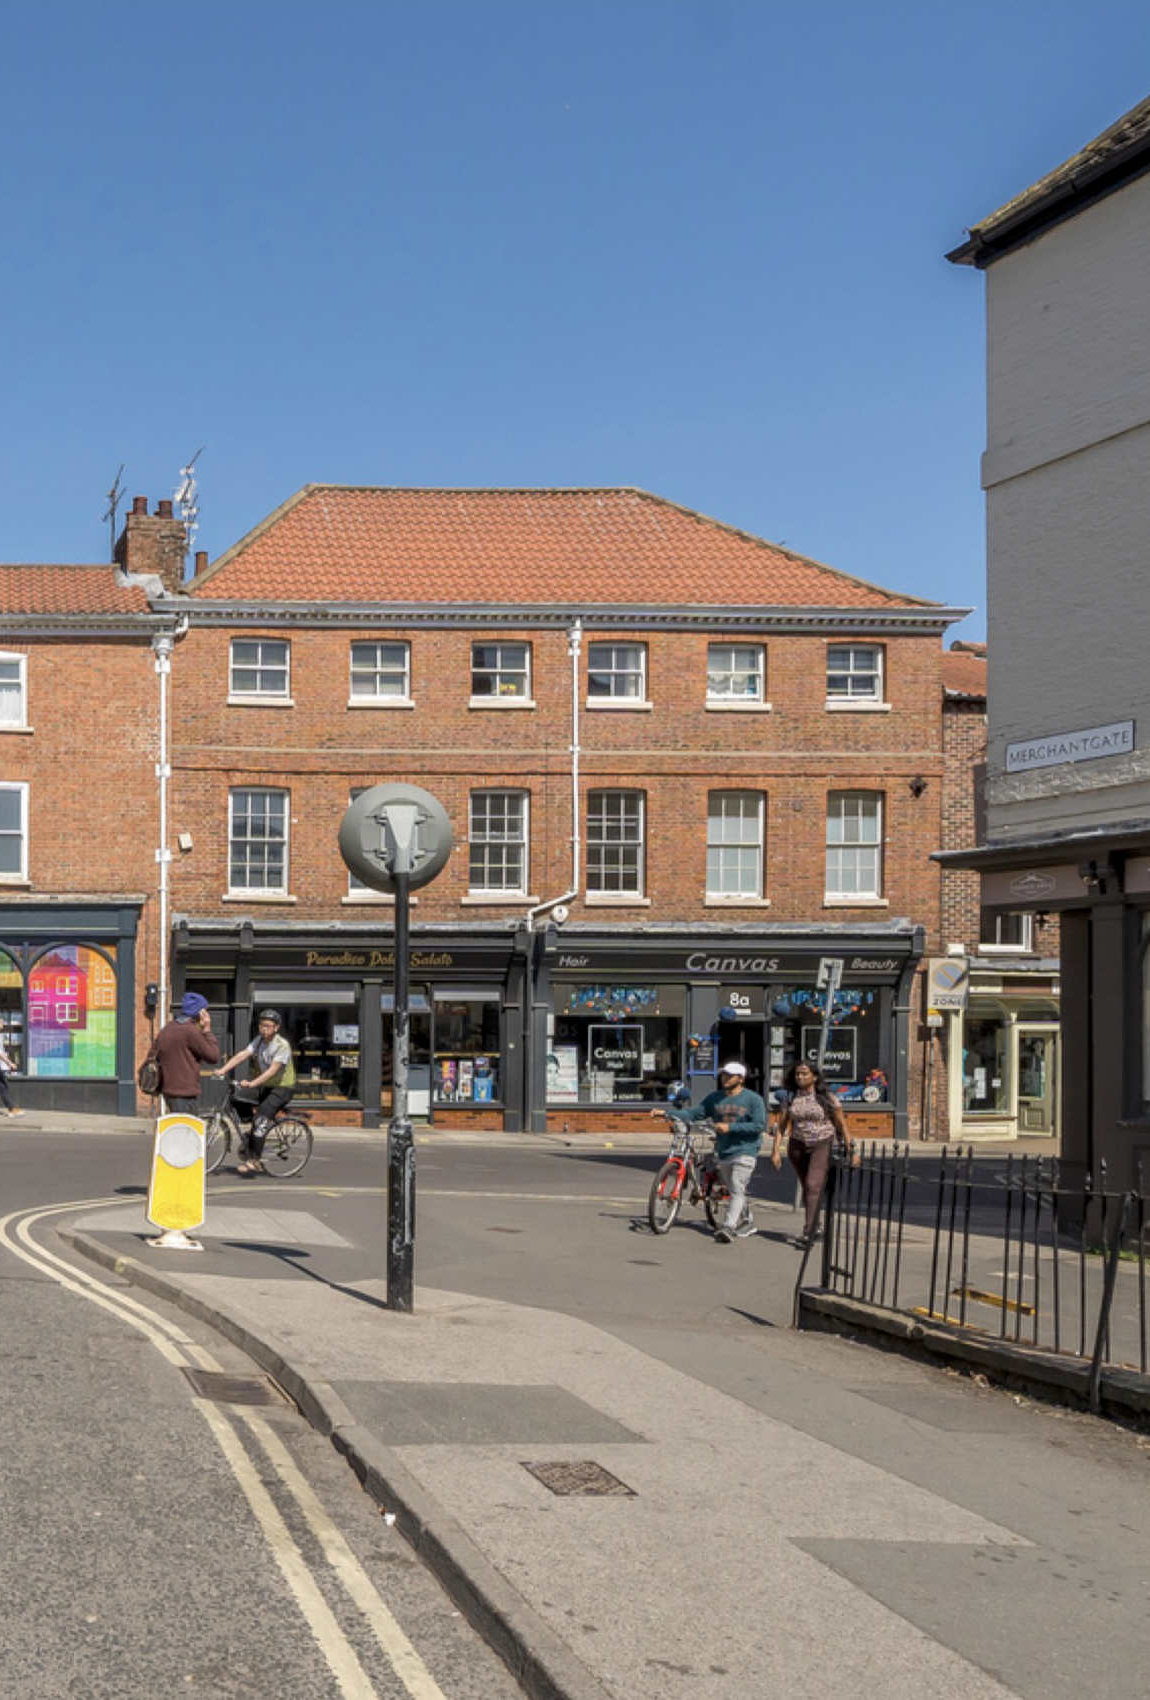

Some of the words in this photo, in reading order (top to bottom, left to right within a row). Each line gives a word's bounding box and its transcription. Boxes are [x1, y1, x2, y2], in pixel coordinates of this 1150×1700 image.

[1010, 730, 1129, 763] MERCHANTGATE
[558, 955, 590, 967] Hair
[685, 953, 779, 971] Canvas
[851, 957, 898, 971] Beauty
[729, 992, 750, 1006] 8a
[594, 1047, 638, 1059] Canvas
[808, 1049, 851, 1060] Cnvas
